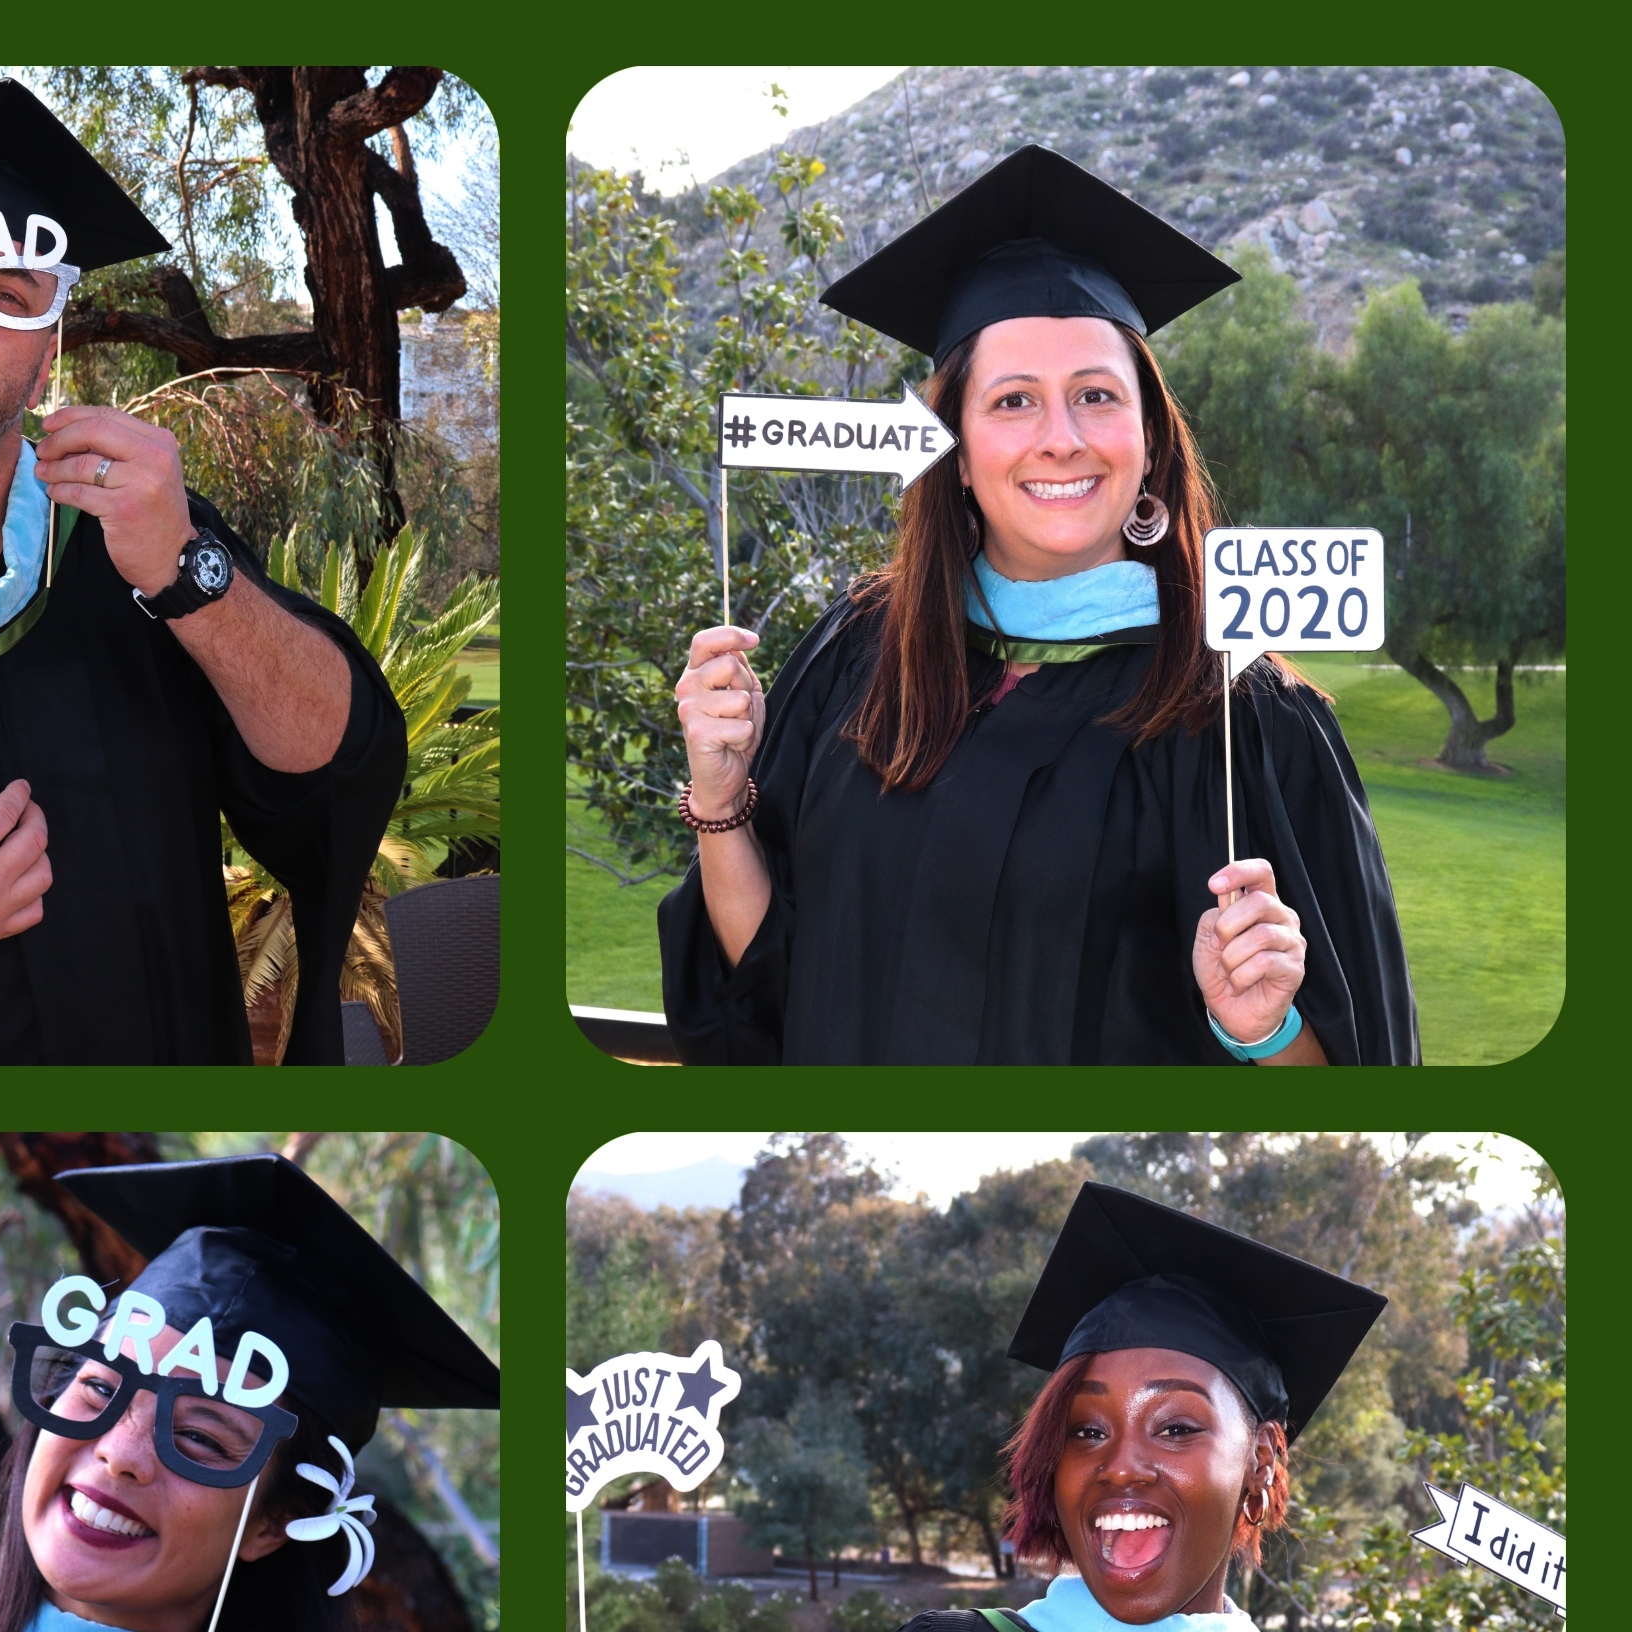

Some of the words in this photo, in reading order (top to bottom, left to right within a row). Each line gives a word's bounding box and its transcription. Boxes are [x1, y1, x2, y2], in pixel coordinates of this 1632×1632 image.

[724, 415, 938, 453] #GRADUATE
[1215, 539, 1316, 576] CLASS
[1327, 539, 1368, 576] OF
[1219, 585, 1368, 639] 2020
[41, 1275, 289, 1408] GRAD
[602, 1367, 671, 1416] JUST
[1465, 1501, 1490, 1546] I
[1490, 1527, 1535, 1575] did
[1541, 1551, 1566, 1590] it
